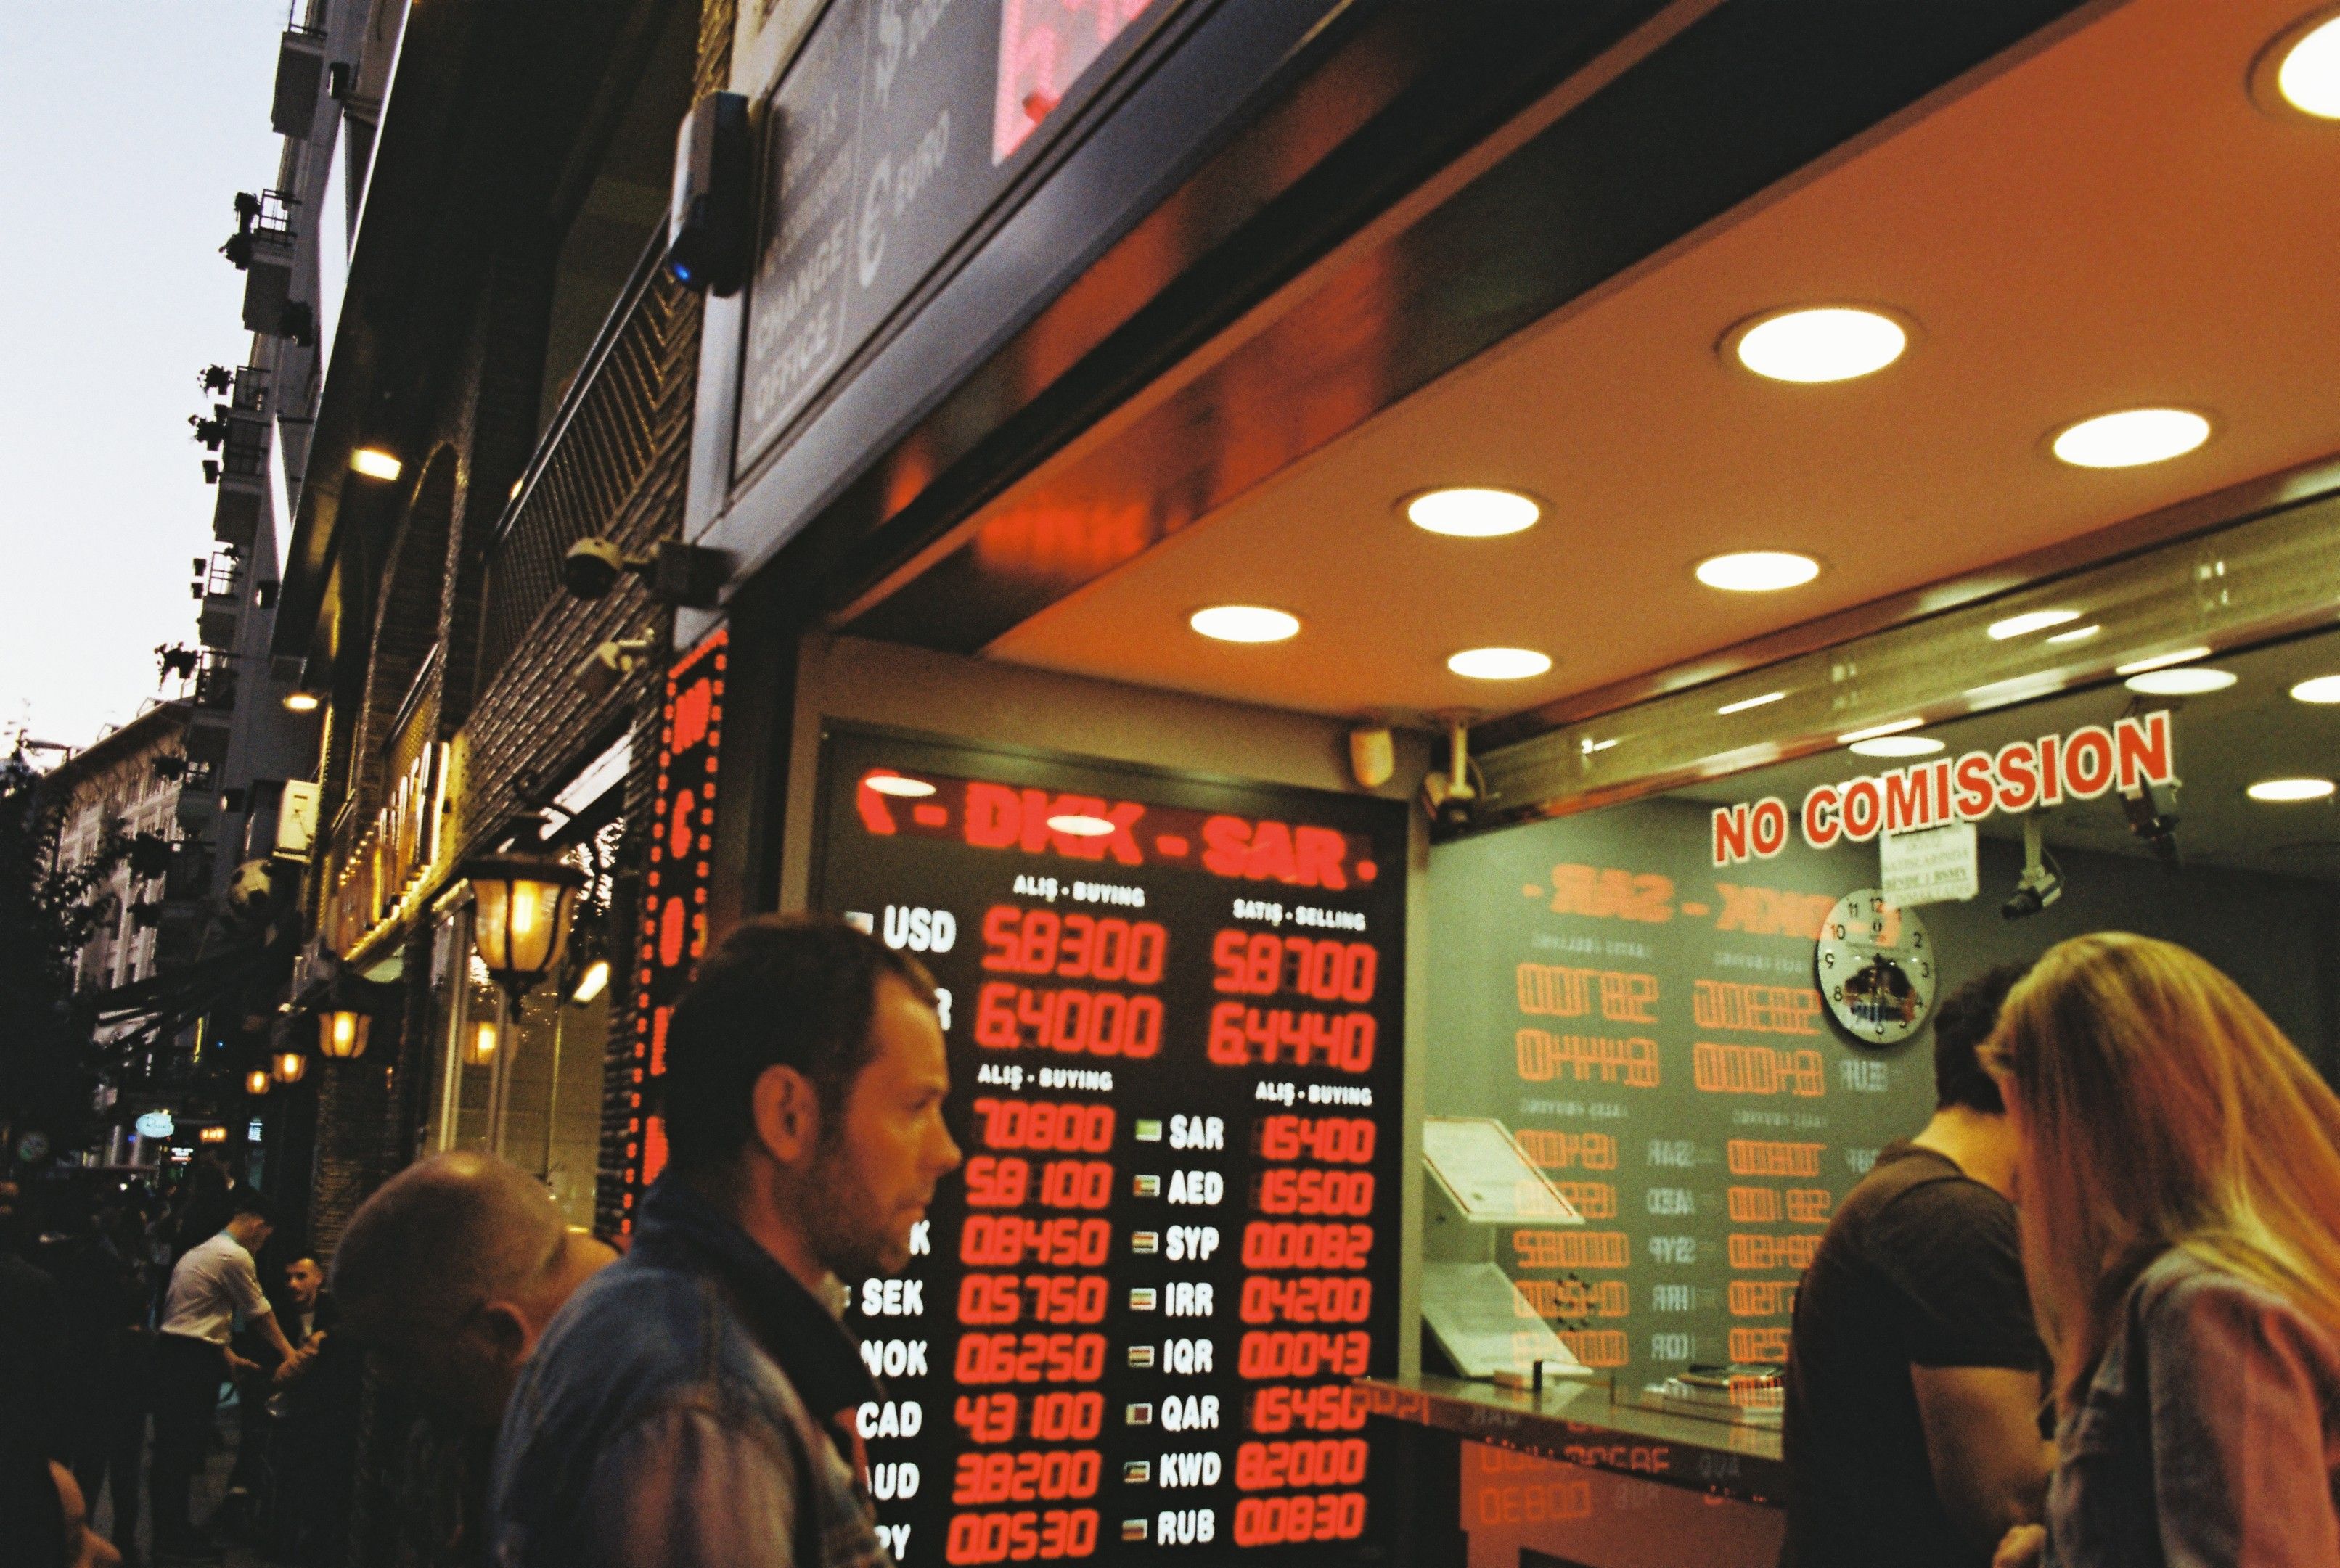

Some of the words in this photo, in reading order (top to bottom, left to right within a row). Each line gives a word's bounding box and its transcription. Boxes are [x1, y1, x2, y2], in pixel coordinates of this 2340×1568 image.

[1713, 797, 1788, 866] NO
[1802, 710, 2172, 849] COMISSION
[1202, 815, 1346, 890] SAR
[1073, 879, 1145, 908] BUYING
[884, 905, 957, 953] USD
[1296, 906, 1366, 931] SELLING
[1830, 924, 1845, 940] 10
[1833, 986, 1843, 1001] 8
[978, 1064, 1023, 1091] ALIŞ
[1039, 1067, 1113, 1091] BUYING
[1308, 1084, 1372, 1107] BUYING
[1169, 1114, 1224, 1150] SAR
[1168, 1170, 1224, 1205] AED
[1166, 1225, 1219, 1261] SYP
[862, 1278, 923, 1316] SEK
[1165, 1282, 1214, 1317] IRR
[860, 1339, 928, 1377] NOK
[1163, 1339, 1213, 1374] IQR
[856, 1401, 922, 1440] CAD
[1161, 1395, 1219, 1432] QAR
[864, 1463, 920, 1501] UD
[1160, 1451, 1222, 1488] KWD
[1158, 1509, 1215, 1546] RUB
